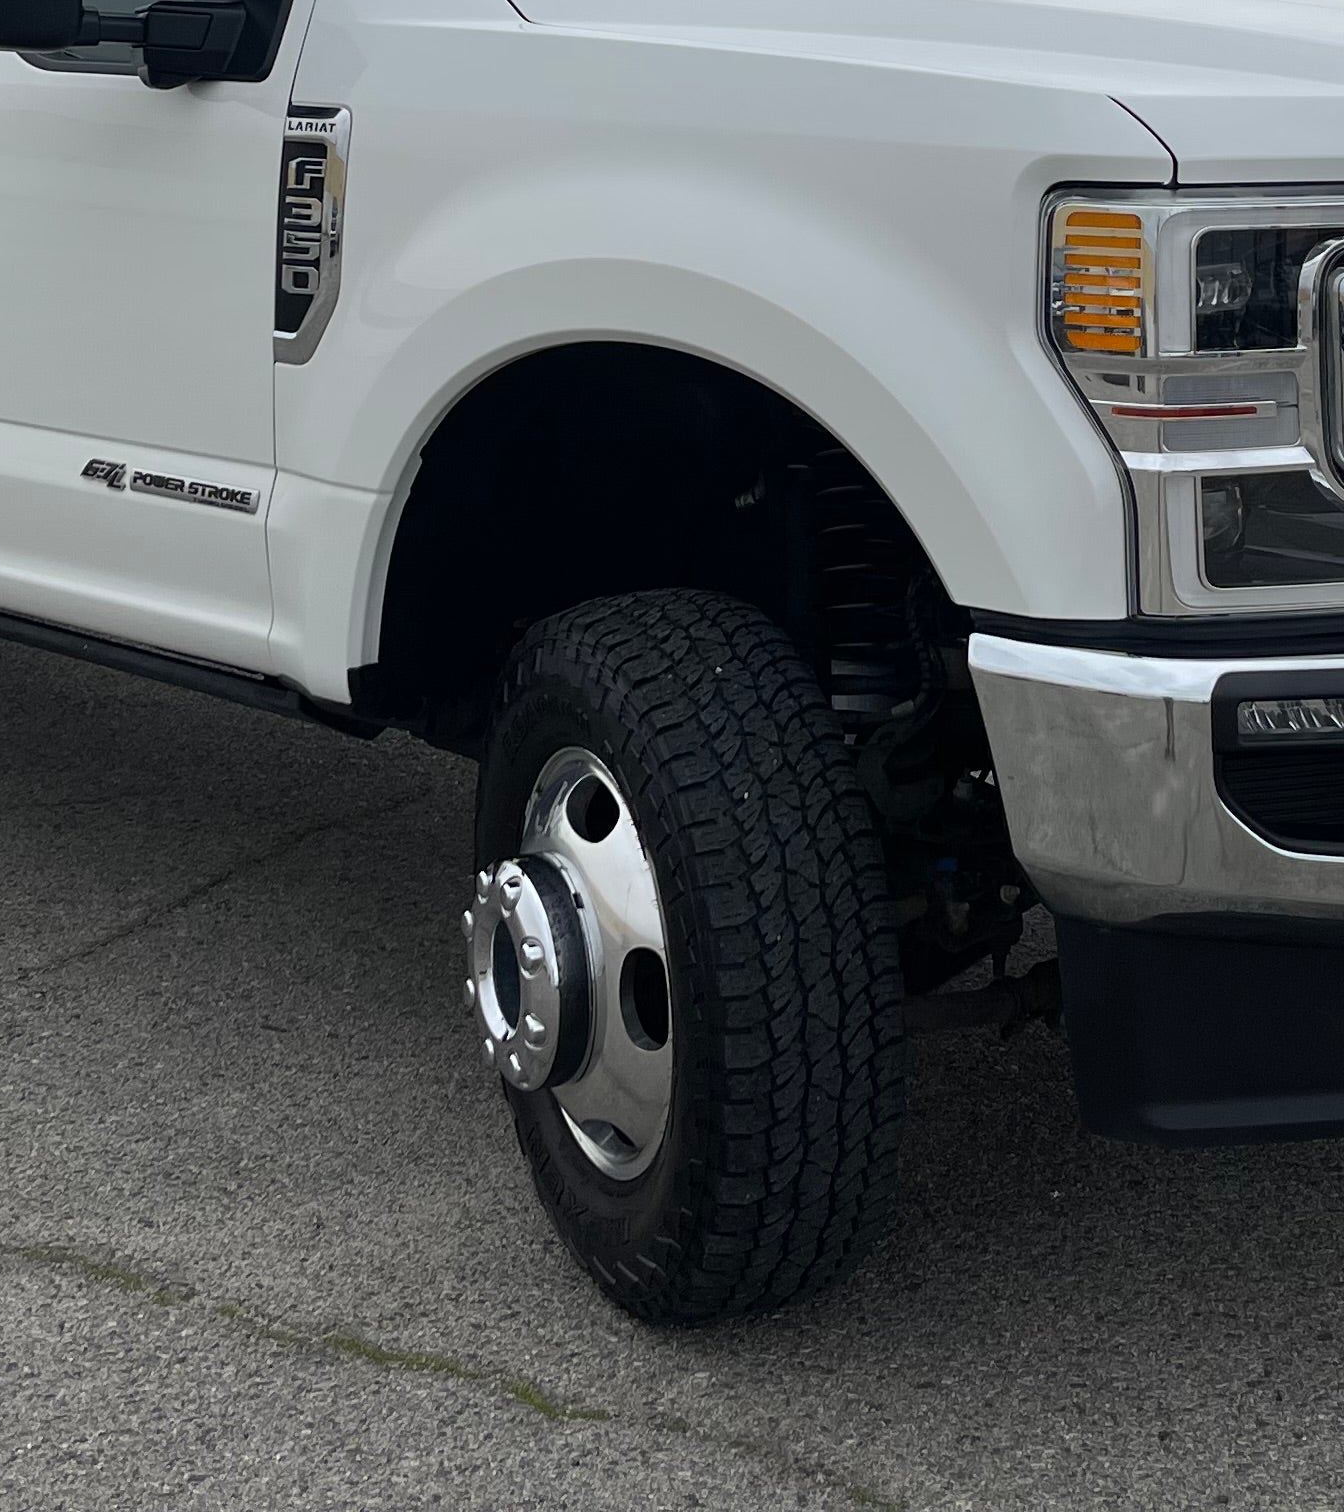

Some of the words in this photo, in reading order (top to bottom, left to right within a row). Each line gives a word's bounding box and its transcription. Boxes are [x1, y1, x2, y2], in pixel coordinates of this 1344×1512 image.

[287, 119, 337, 134] LARIAT
[132, 471, 186, 493] POWER
[187, 483, 253, 506] STROKE
